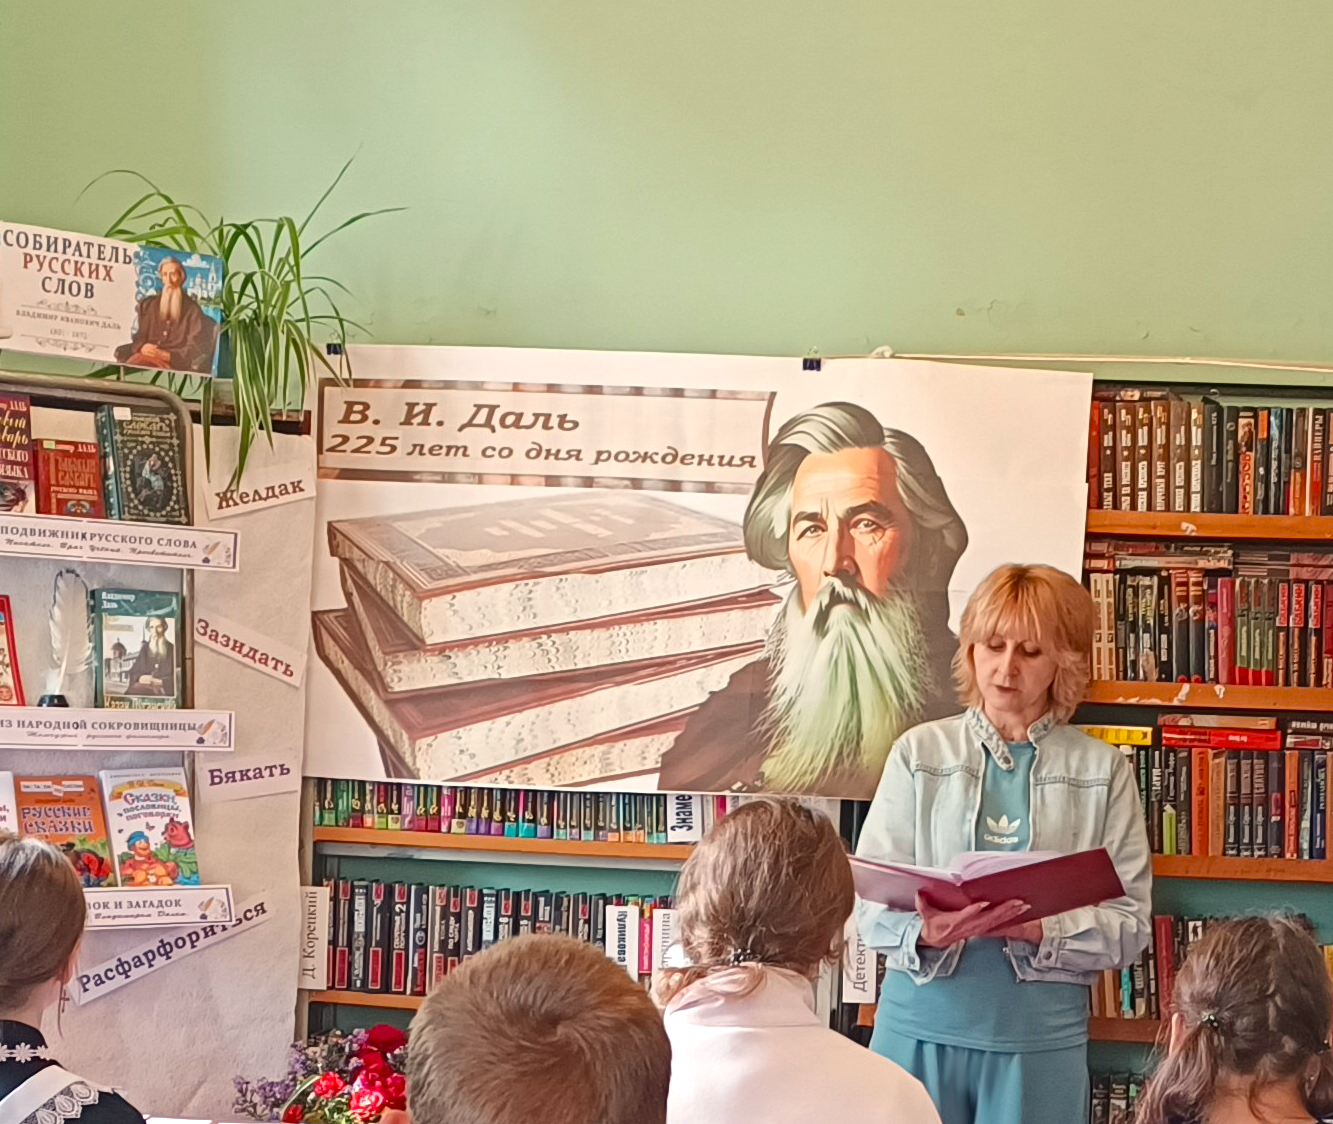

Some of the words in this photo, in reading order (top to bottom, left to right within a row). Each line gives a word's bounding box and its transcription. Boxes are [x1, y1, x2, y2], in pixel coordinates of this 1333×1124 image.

[3, 229, 133, 265] СОБИРАТЕЛЬ
[23, 252, 114, 282] РУССКИХ
[41, 276, 95, 299] СЛОВ
[16, 309, 58, 321] ВЛАДИМИР
[60, 316, 100, 327] ИВАНОВИЧ
[101, 321, 121, 330] ДАЛЬ
[338, 401, 381, 427] В.
[400, 402, 445, 428] И.
[458, 403, 580, 434] Даль
[325, 434, 400, 456] 225
[406, 442, 471, 459] лет
[481, 444, 515, 460] со
[525, 441, 584, 462] дня
[591, 446, 758, 470] рождения
[215, 478, 306, 511] Желдак
[0, 526, 88, 541] ПОДВИЖНИК
[89, 532, 154, 546] РУССКОГО
[157, 538, 198, 549] СЛОВА
[195, 618, 296, 679] Зазидать
[17, 719, 88, 730] НАРОДНОЙ
[91, 721, 197, 732] СОКРОВИЩНИЦЫ
[209, 763, 291, 786] Бякать
[21, 806, 93, 820] РУССКИЕ
[24, 820, 95, 834] СКАЗКИ
[115, 901, 123, 909] И
[127, 899, 183, 909] ЗАГАДОК
[302, 890, 319, 960] Корецкий
[616, 911, 628, 963] Куликова
[77, 901, 268, 993] Расфарфориться
